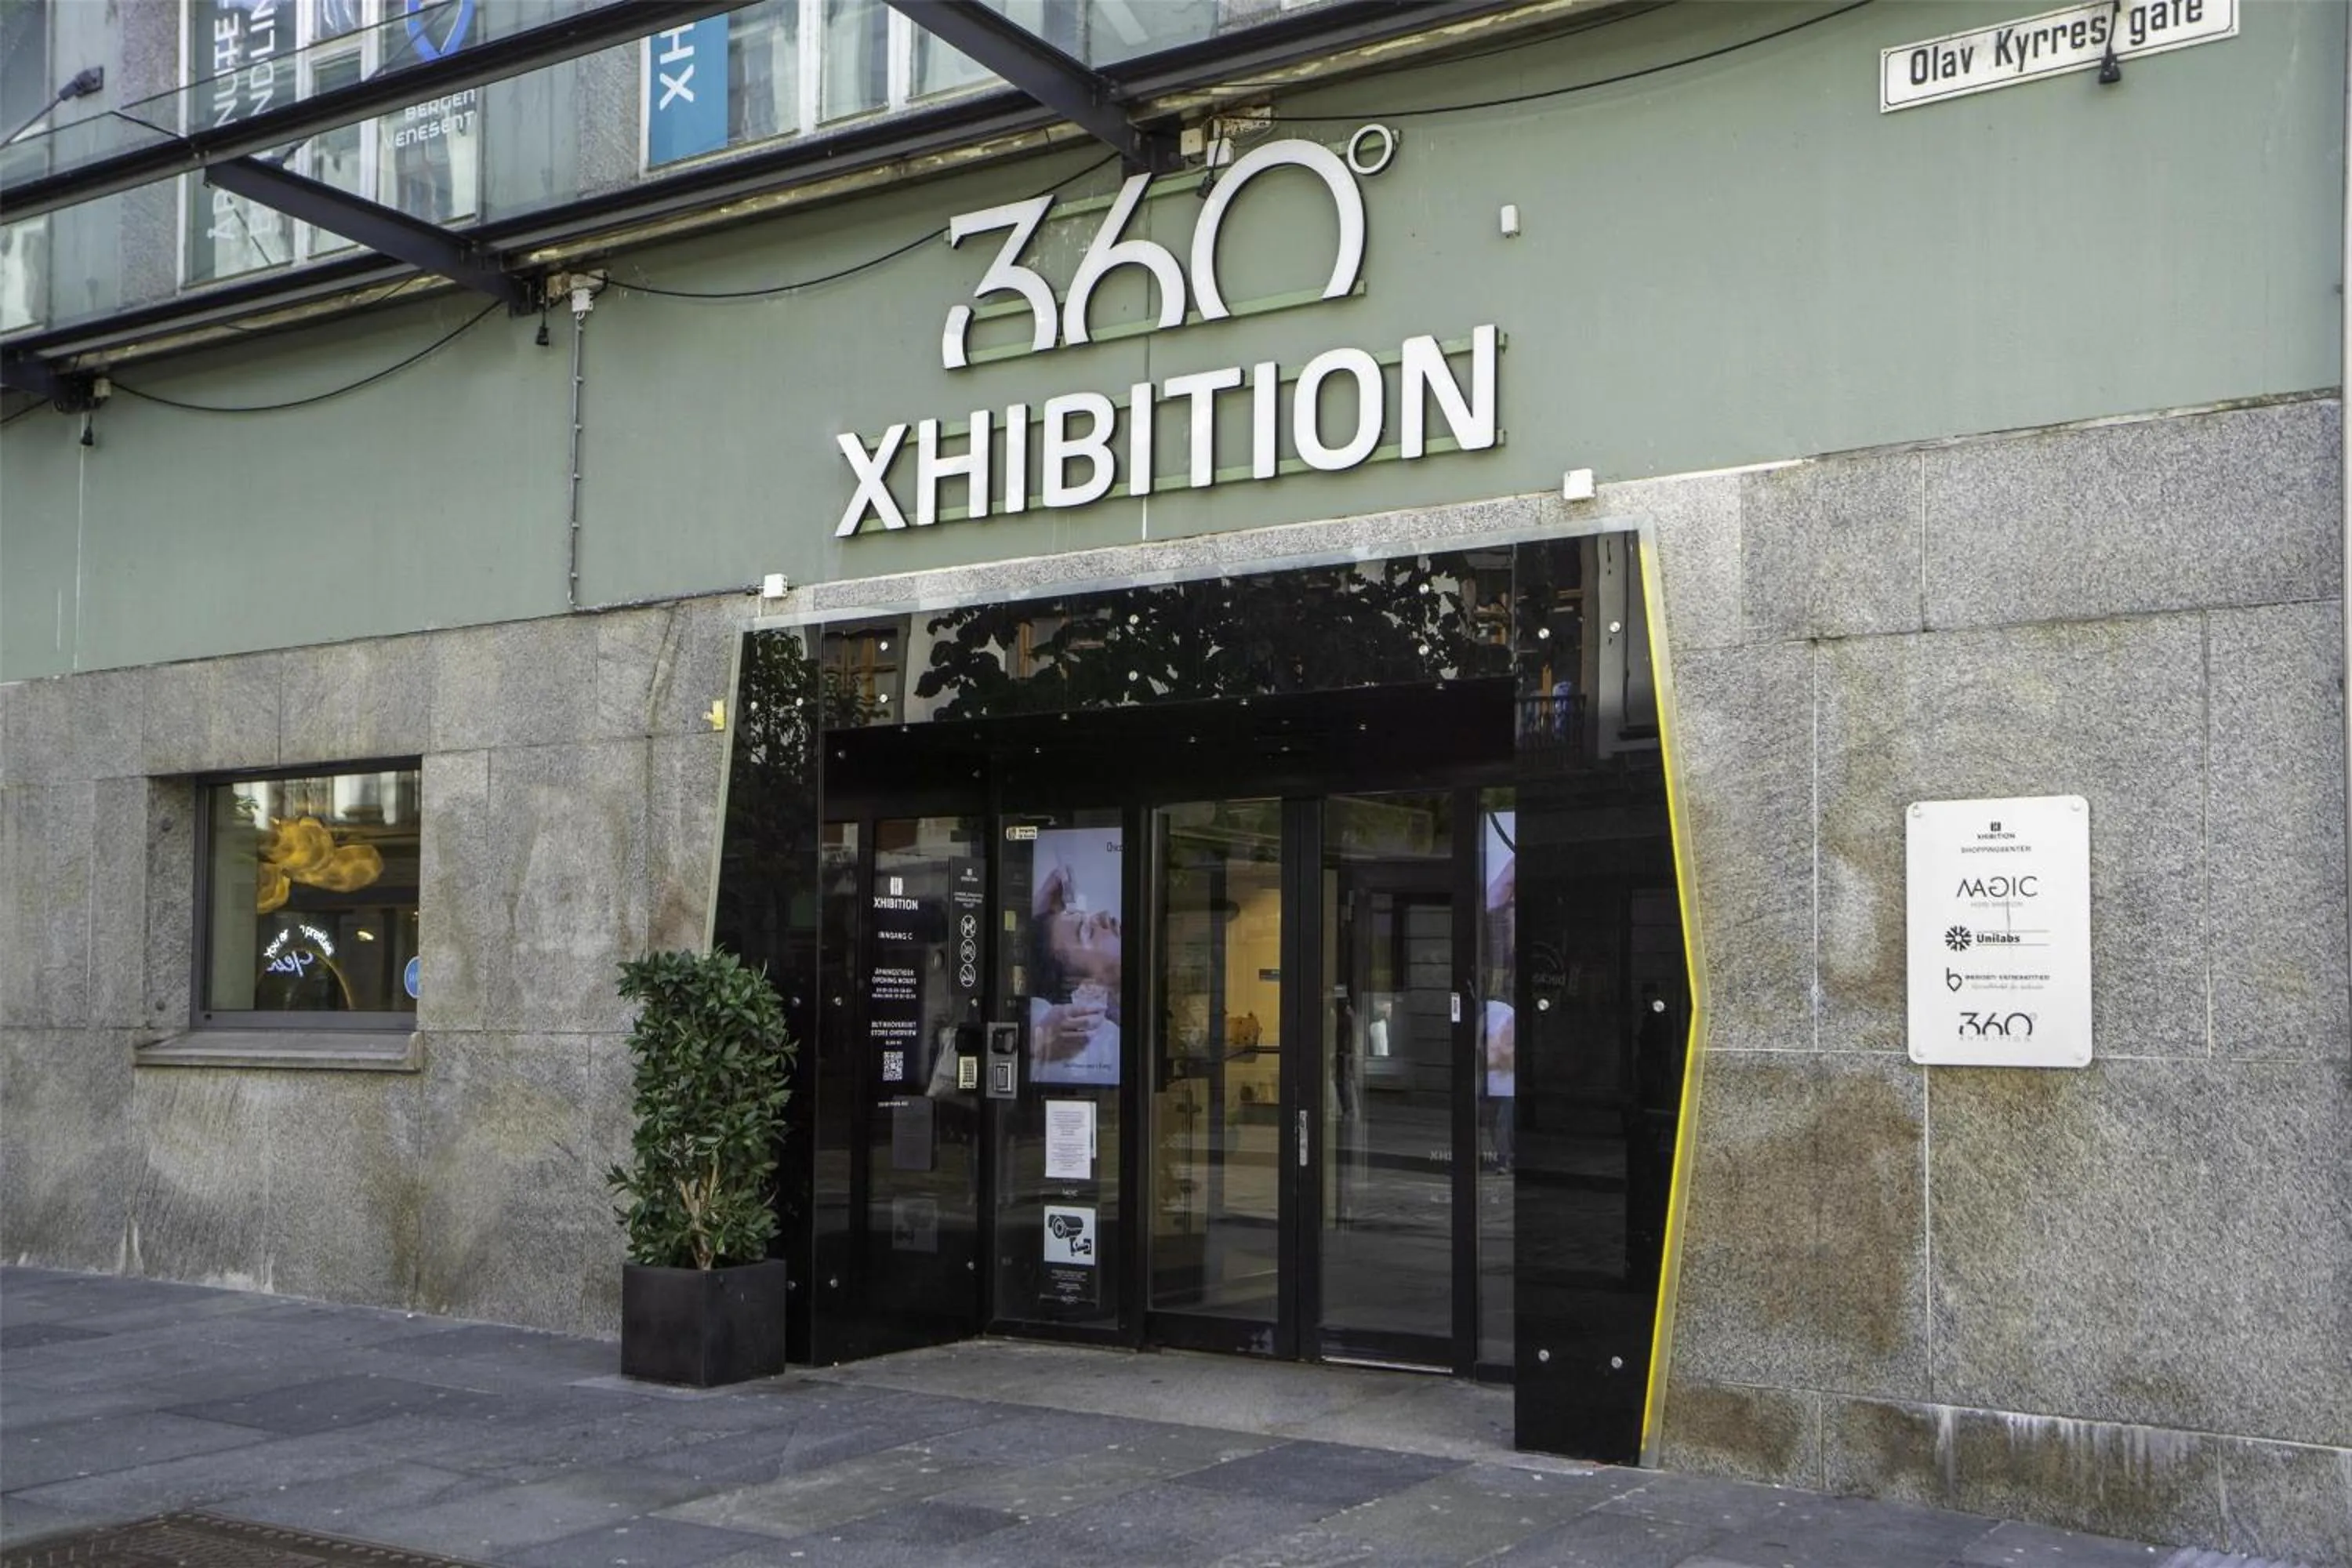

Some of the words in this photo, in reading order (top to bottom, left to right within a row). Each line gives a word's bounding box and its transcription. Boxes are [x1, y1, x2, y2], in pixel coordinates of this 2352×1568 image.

[1910, 45, 1974, 85] Olav
[1994, 14, 2107, 72] Kyrres
[2129, 0, 2204, 46] gate
[405, 89, 476, 121] BERGEN
[385, 111, 477, 150] VENESENT
[835, 323, 1498, 538] XHIBITION
[1956, 875, 2038, 898] MAGIC
[873, 896, 919, 911] XHIBITION
[1976, 932, 2020, 943] Unilabs
